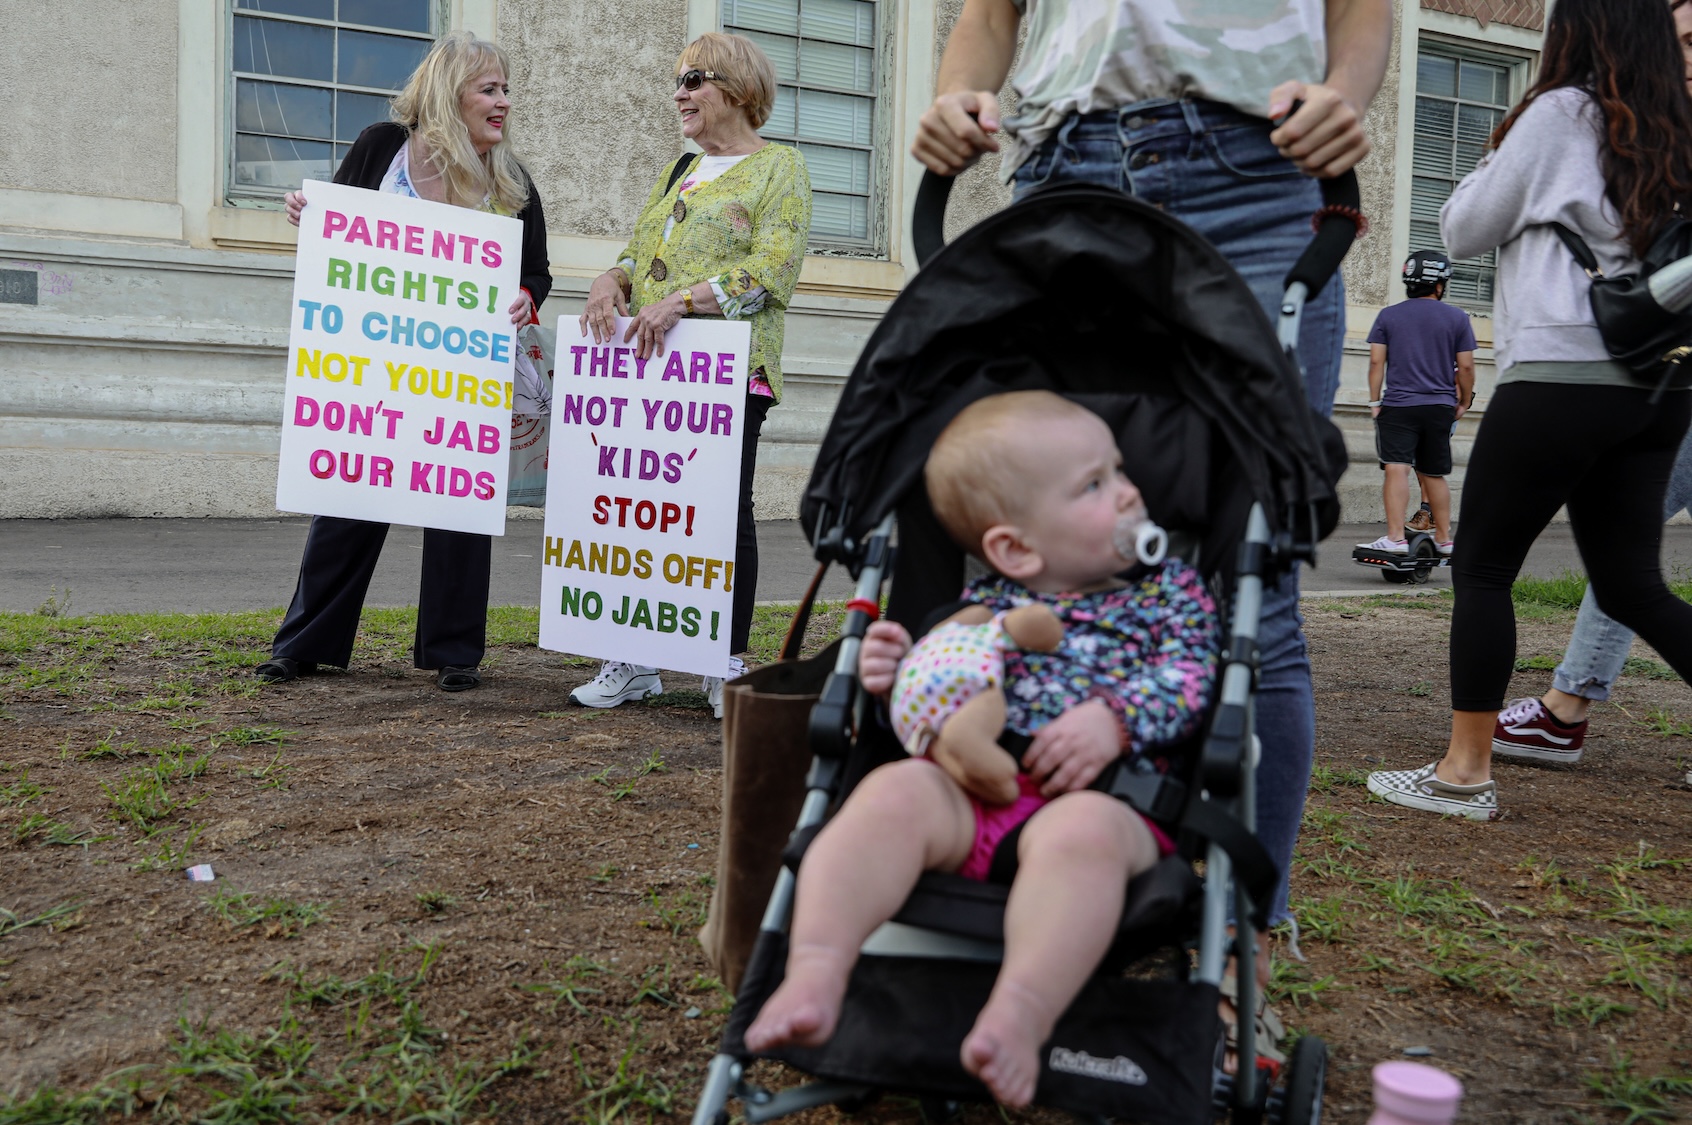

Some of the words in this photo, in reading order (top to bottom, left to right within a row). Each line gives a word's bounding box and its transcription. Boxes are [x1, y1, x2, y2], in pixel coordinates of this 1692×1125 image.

[322, 209, 503, 269] PARENTS
[326, 257, 499, 314] RIGHTS!
[298, 300, 344, 335] TO
[361, 311, 511, 364] CHOOSE
[295, 347, 371, 386] NOT
[384, 359, 514, 411] YOURS!
[570, 345, 648, 379] THEY
[661, 350, 736, 385] ARE
[293, 395, 404, 440] DON'T
[423, 416, 501, 455] JAB
[563, 394, 629, 428] NOT
[641, 398, 734, 436] YOUR
[309, 448, 395, 488] OUR
[409, 460, 496, 501] KIDS
[592, 494, 696, 537] STOP!
[543, 536, 653, 580] HANDS
[662, 552, 734, 593] OFF!
[560, 585, 604, 622] NO
